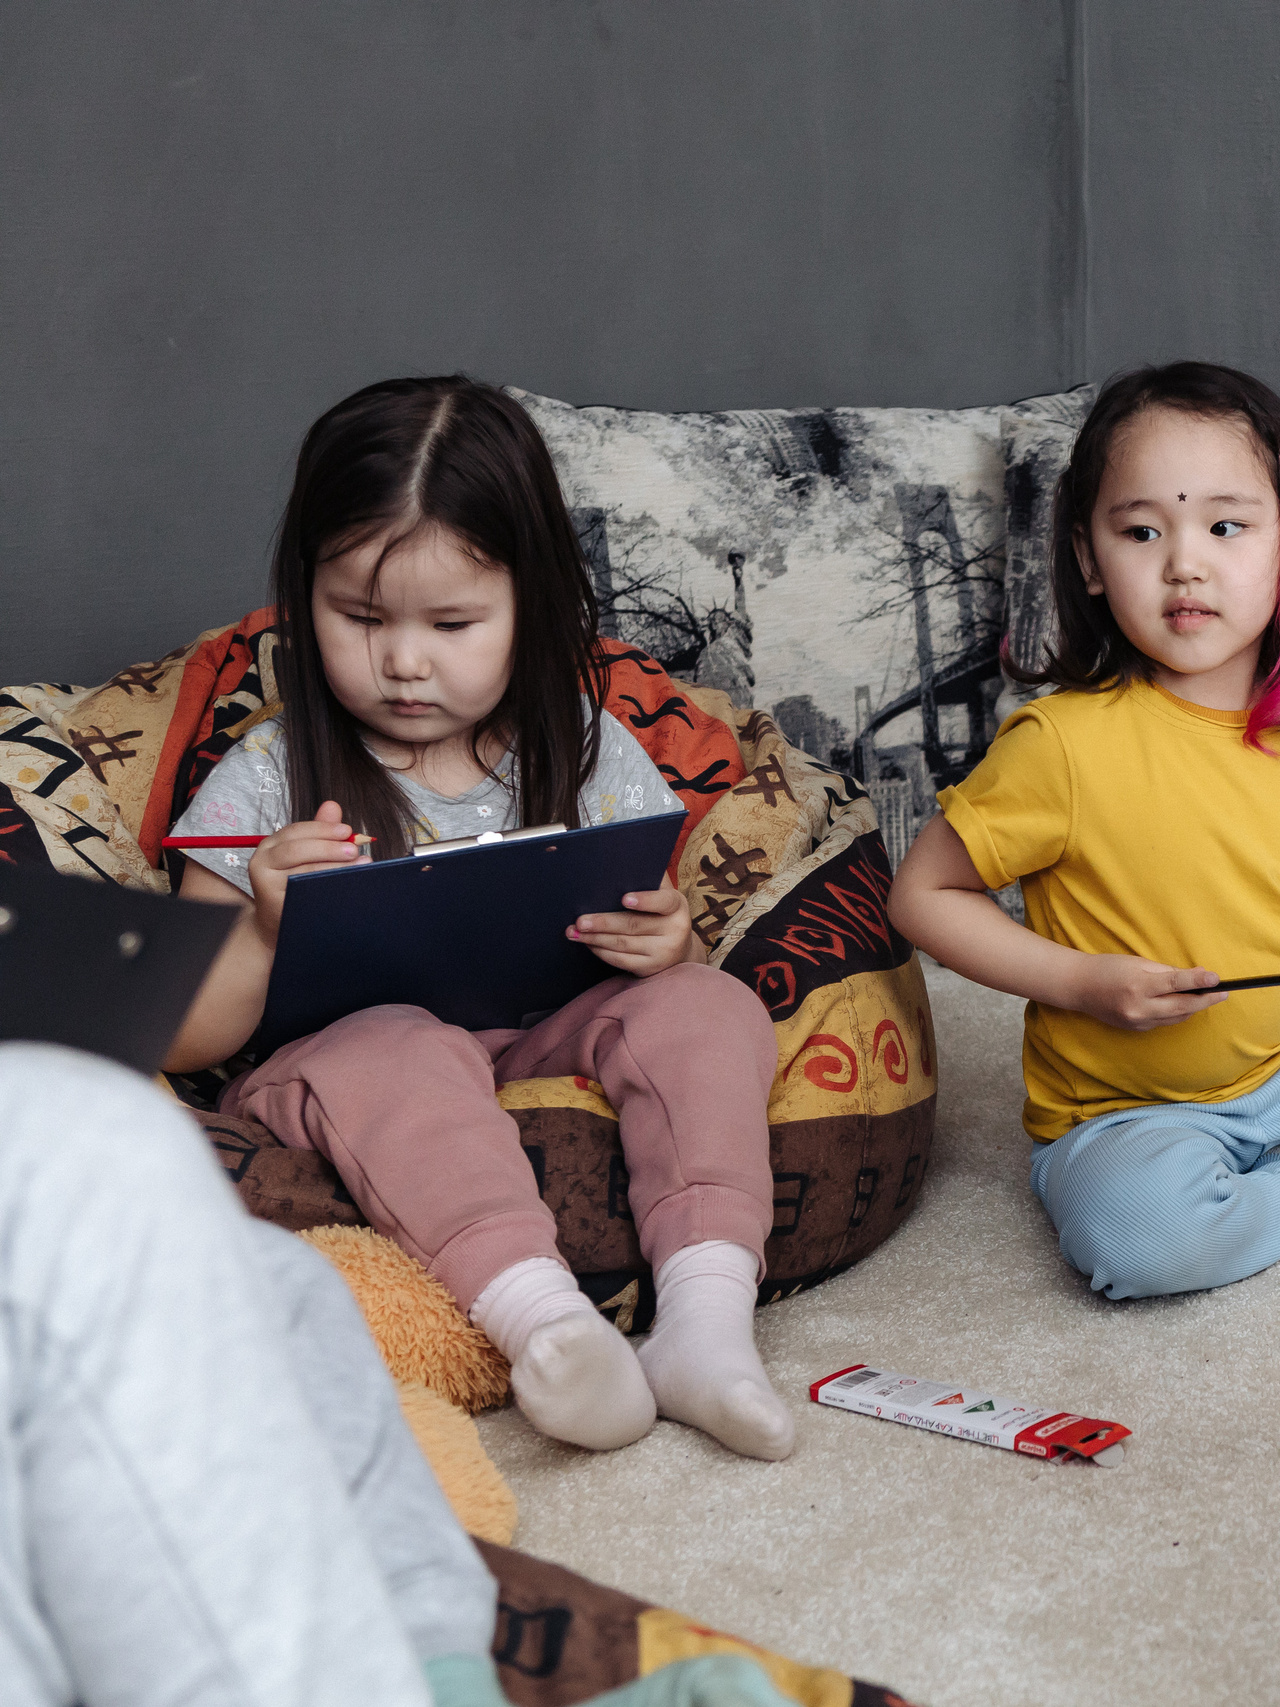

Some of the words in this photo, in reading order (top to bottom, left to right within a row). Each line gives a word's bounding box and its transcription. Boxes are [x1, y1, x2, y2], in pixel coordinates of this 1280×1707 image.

[876, 1406, 882, 1417] 6
[893, 1412, 953, 1433] КАРАНДАШИ
[957, 1426, 1000, 1445] ЦВЕТНЫЕ
